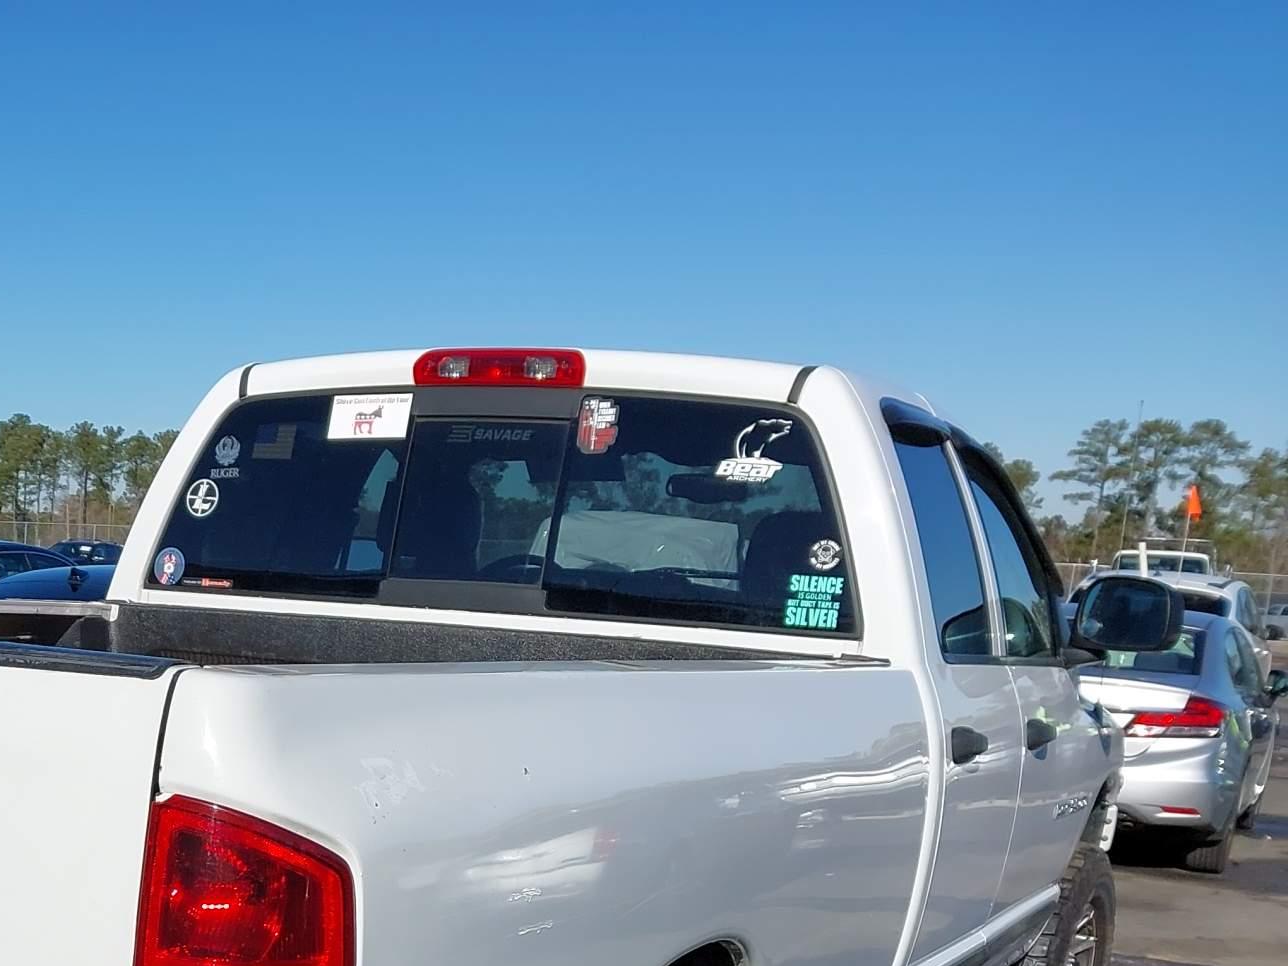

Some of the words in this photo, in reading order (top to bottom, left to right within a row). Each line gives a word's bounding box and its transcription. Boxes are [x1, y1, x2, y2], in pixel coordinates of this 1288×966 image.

[473, 428, 533, 441] SAVAGE
[210, 467, 240, 479] RUGER
[715, 460, 783, 479] Bear
[790, 574, 844, 594] SILENCE
[805, 592, 832, 601] GOLDEN
[786, 607, 838, 628] SILVER
